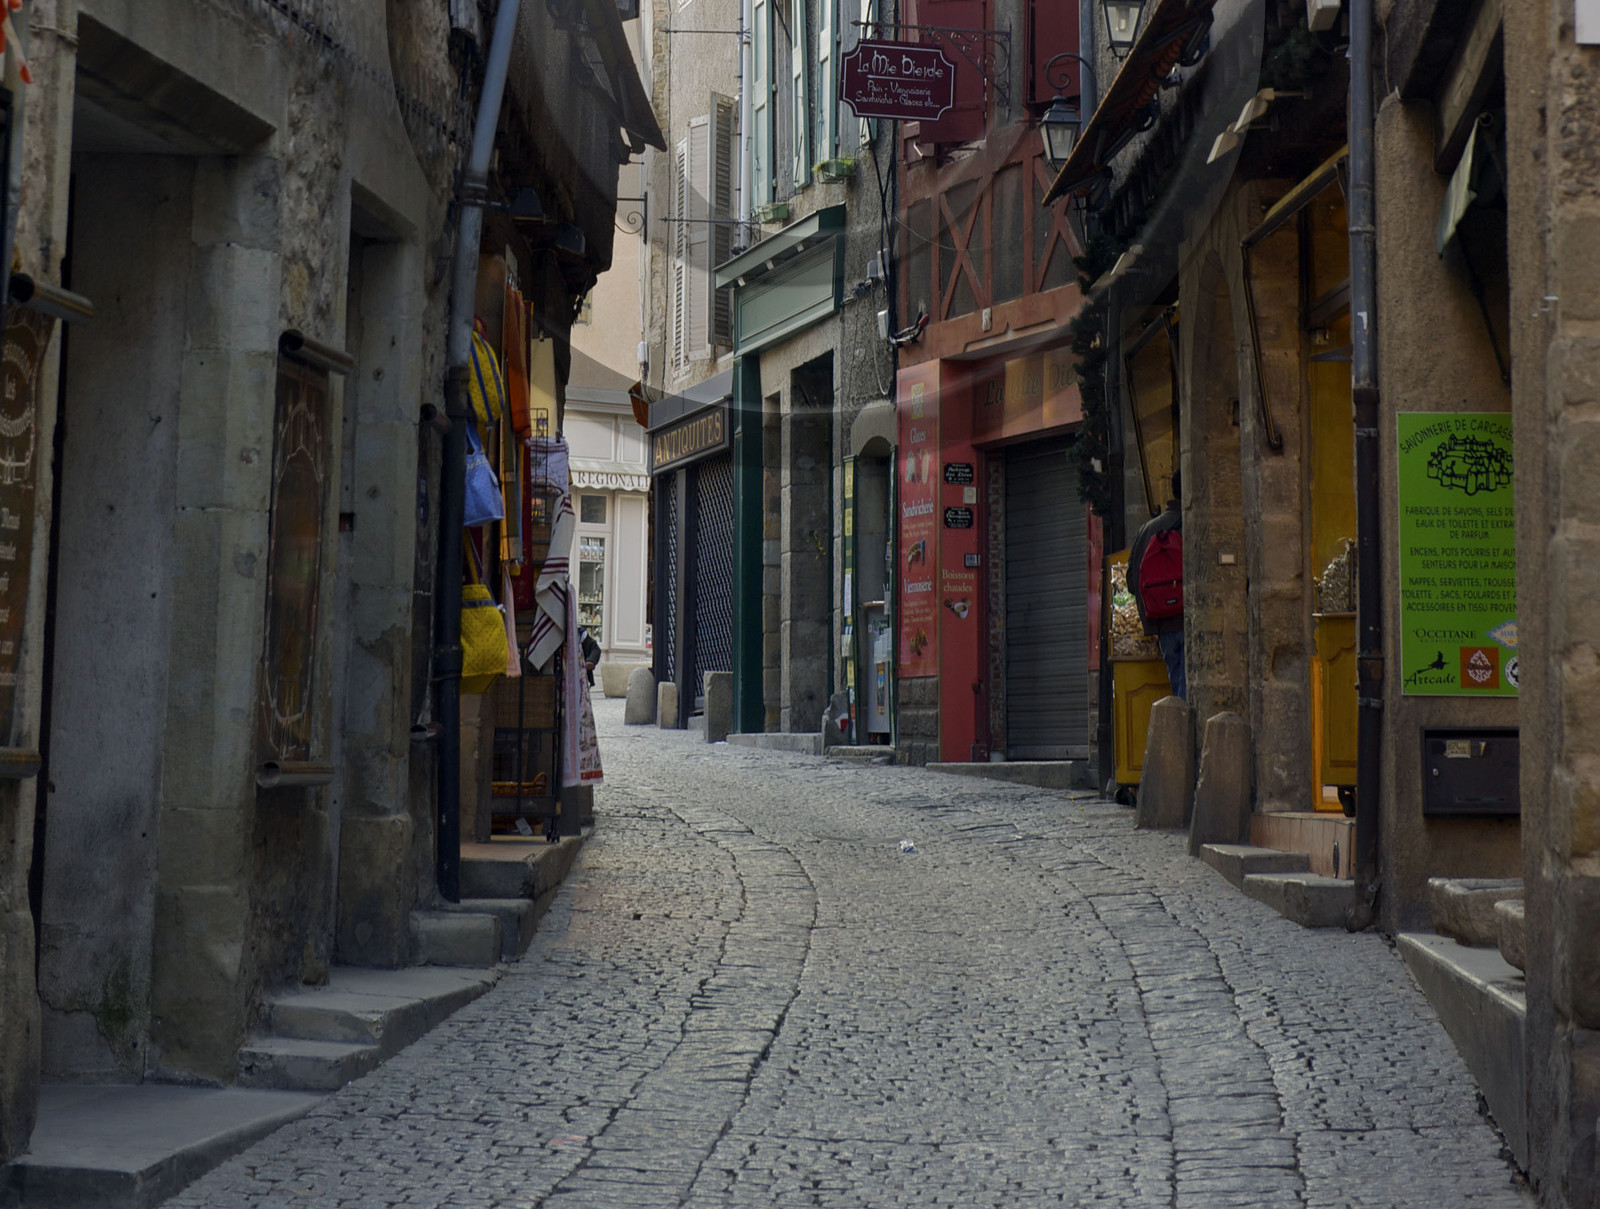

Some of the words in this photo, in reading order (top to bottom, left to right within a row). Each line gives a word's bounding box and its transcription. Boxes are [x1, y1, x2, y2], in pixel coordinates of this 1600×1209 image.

[857, 52, 870, 73] La
[872, 49, 897, 76] Mie
[867, 79, 883, 92] Pain
[899, 93, 923, 107] Glaces
[654, 411, 723, 466] ANTIQUITES
[1400, 420, 1453, 454] SAVONNERIE
[1454, 419, 1467, 431] DE
[1405, 505, 1440, 516] FABRIQUE
[1442, 506, 1452, 516] DE
[1486, 507, 1503, 517] SELS
[1415, 519, 1434, 528] EAUX
[1436, 519, 1446, 528] DE
[1448, 519, 1479, 529] TOILETTE
[1481, 520, 1488, 529] ET
[1449, 530, 1459, 539] DE
[1461, 530, 1490, 539] PARFUM
[1441, 547, 1459, 557] POTS
[1461, 547, 1490, 557] POURRIS
[1492, 548, 1501, 557] ET
[1422, 559, 1457, 569] SENTEURS
[1459, 560, 1478, 569] POUR
[1480, 560, 1489, 569] LA
[942, 568, 975, 580] Boissons
[943, 581, 973, 593] chaudes
[1401, 589, 1432, 599] TOILETTE
[1463, 590, 1501, 600] FOULARDS
[1503, 591, 1510, 600] ET
[1406, 602, 1455, 612] ACCESSOIRES
[1457, 603, 1466, 612] EN
[1468, 603, 1488, 613] TISSU
